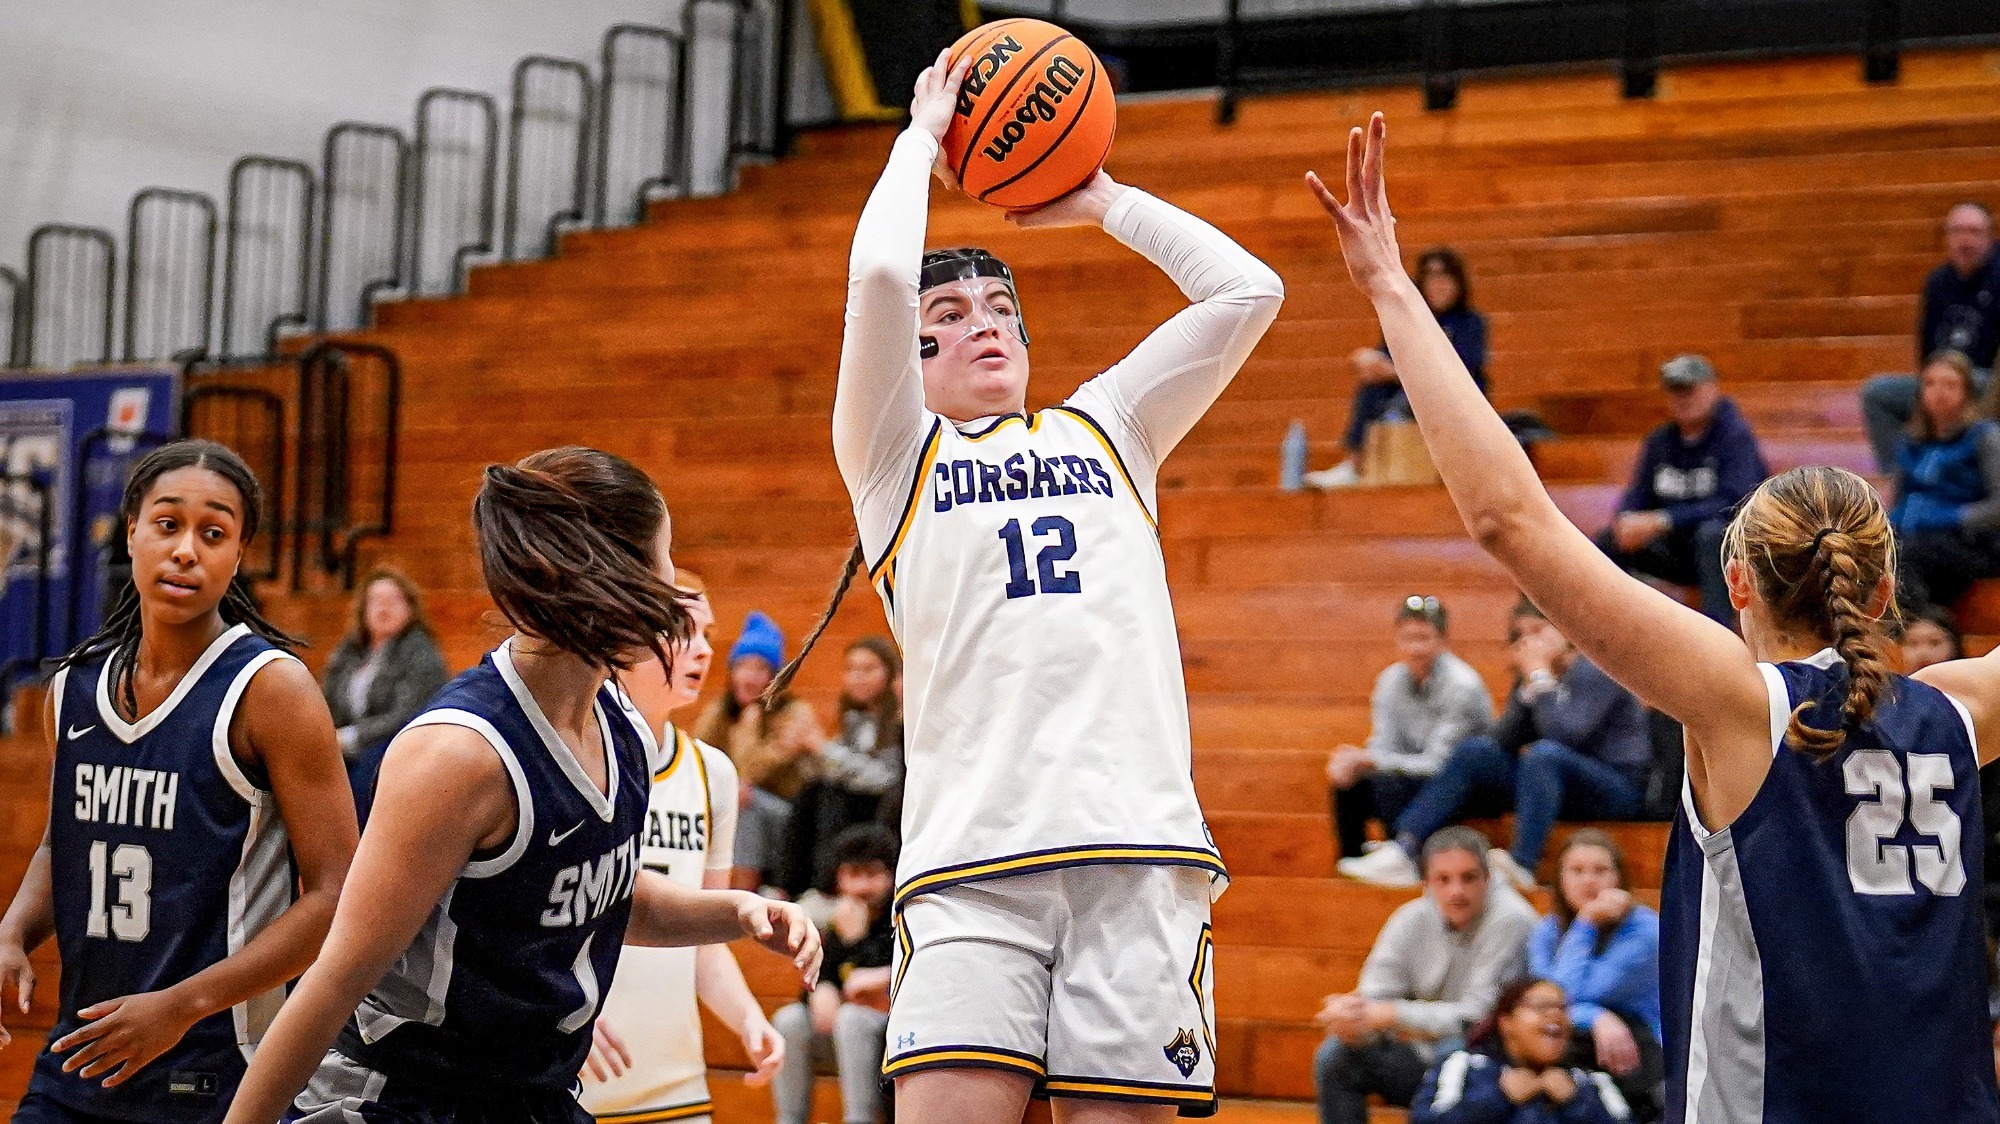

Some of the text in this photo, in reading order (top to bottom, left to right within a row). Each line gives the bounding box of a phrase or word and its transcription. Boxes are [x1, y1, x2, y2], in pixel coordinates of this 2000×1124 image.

[955, 34, 1024, 118] NCAA
[982, 53, 1085, 162] Wilson
[934, 449, 1114, 513] CORSAIRS
[998, 515, 1082, 599] 12
[75, 763, 179, 830] SMITH
[649, 809, 705, 851] AIRS
[1842, 749, 1967, 896] 25
[86, 840, 152, 942] 13
